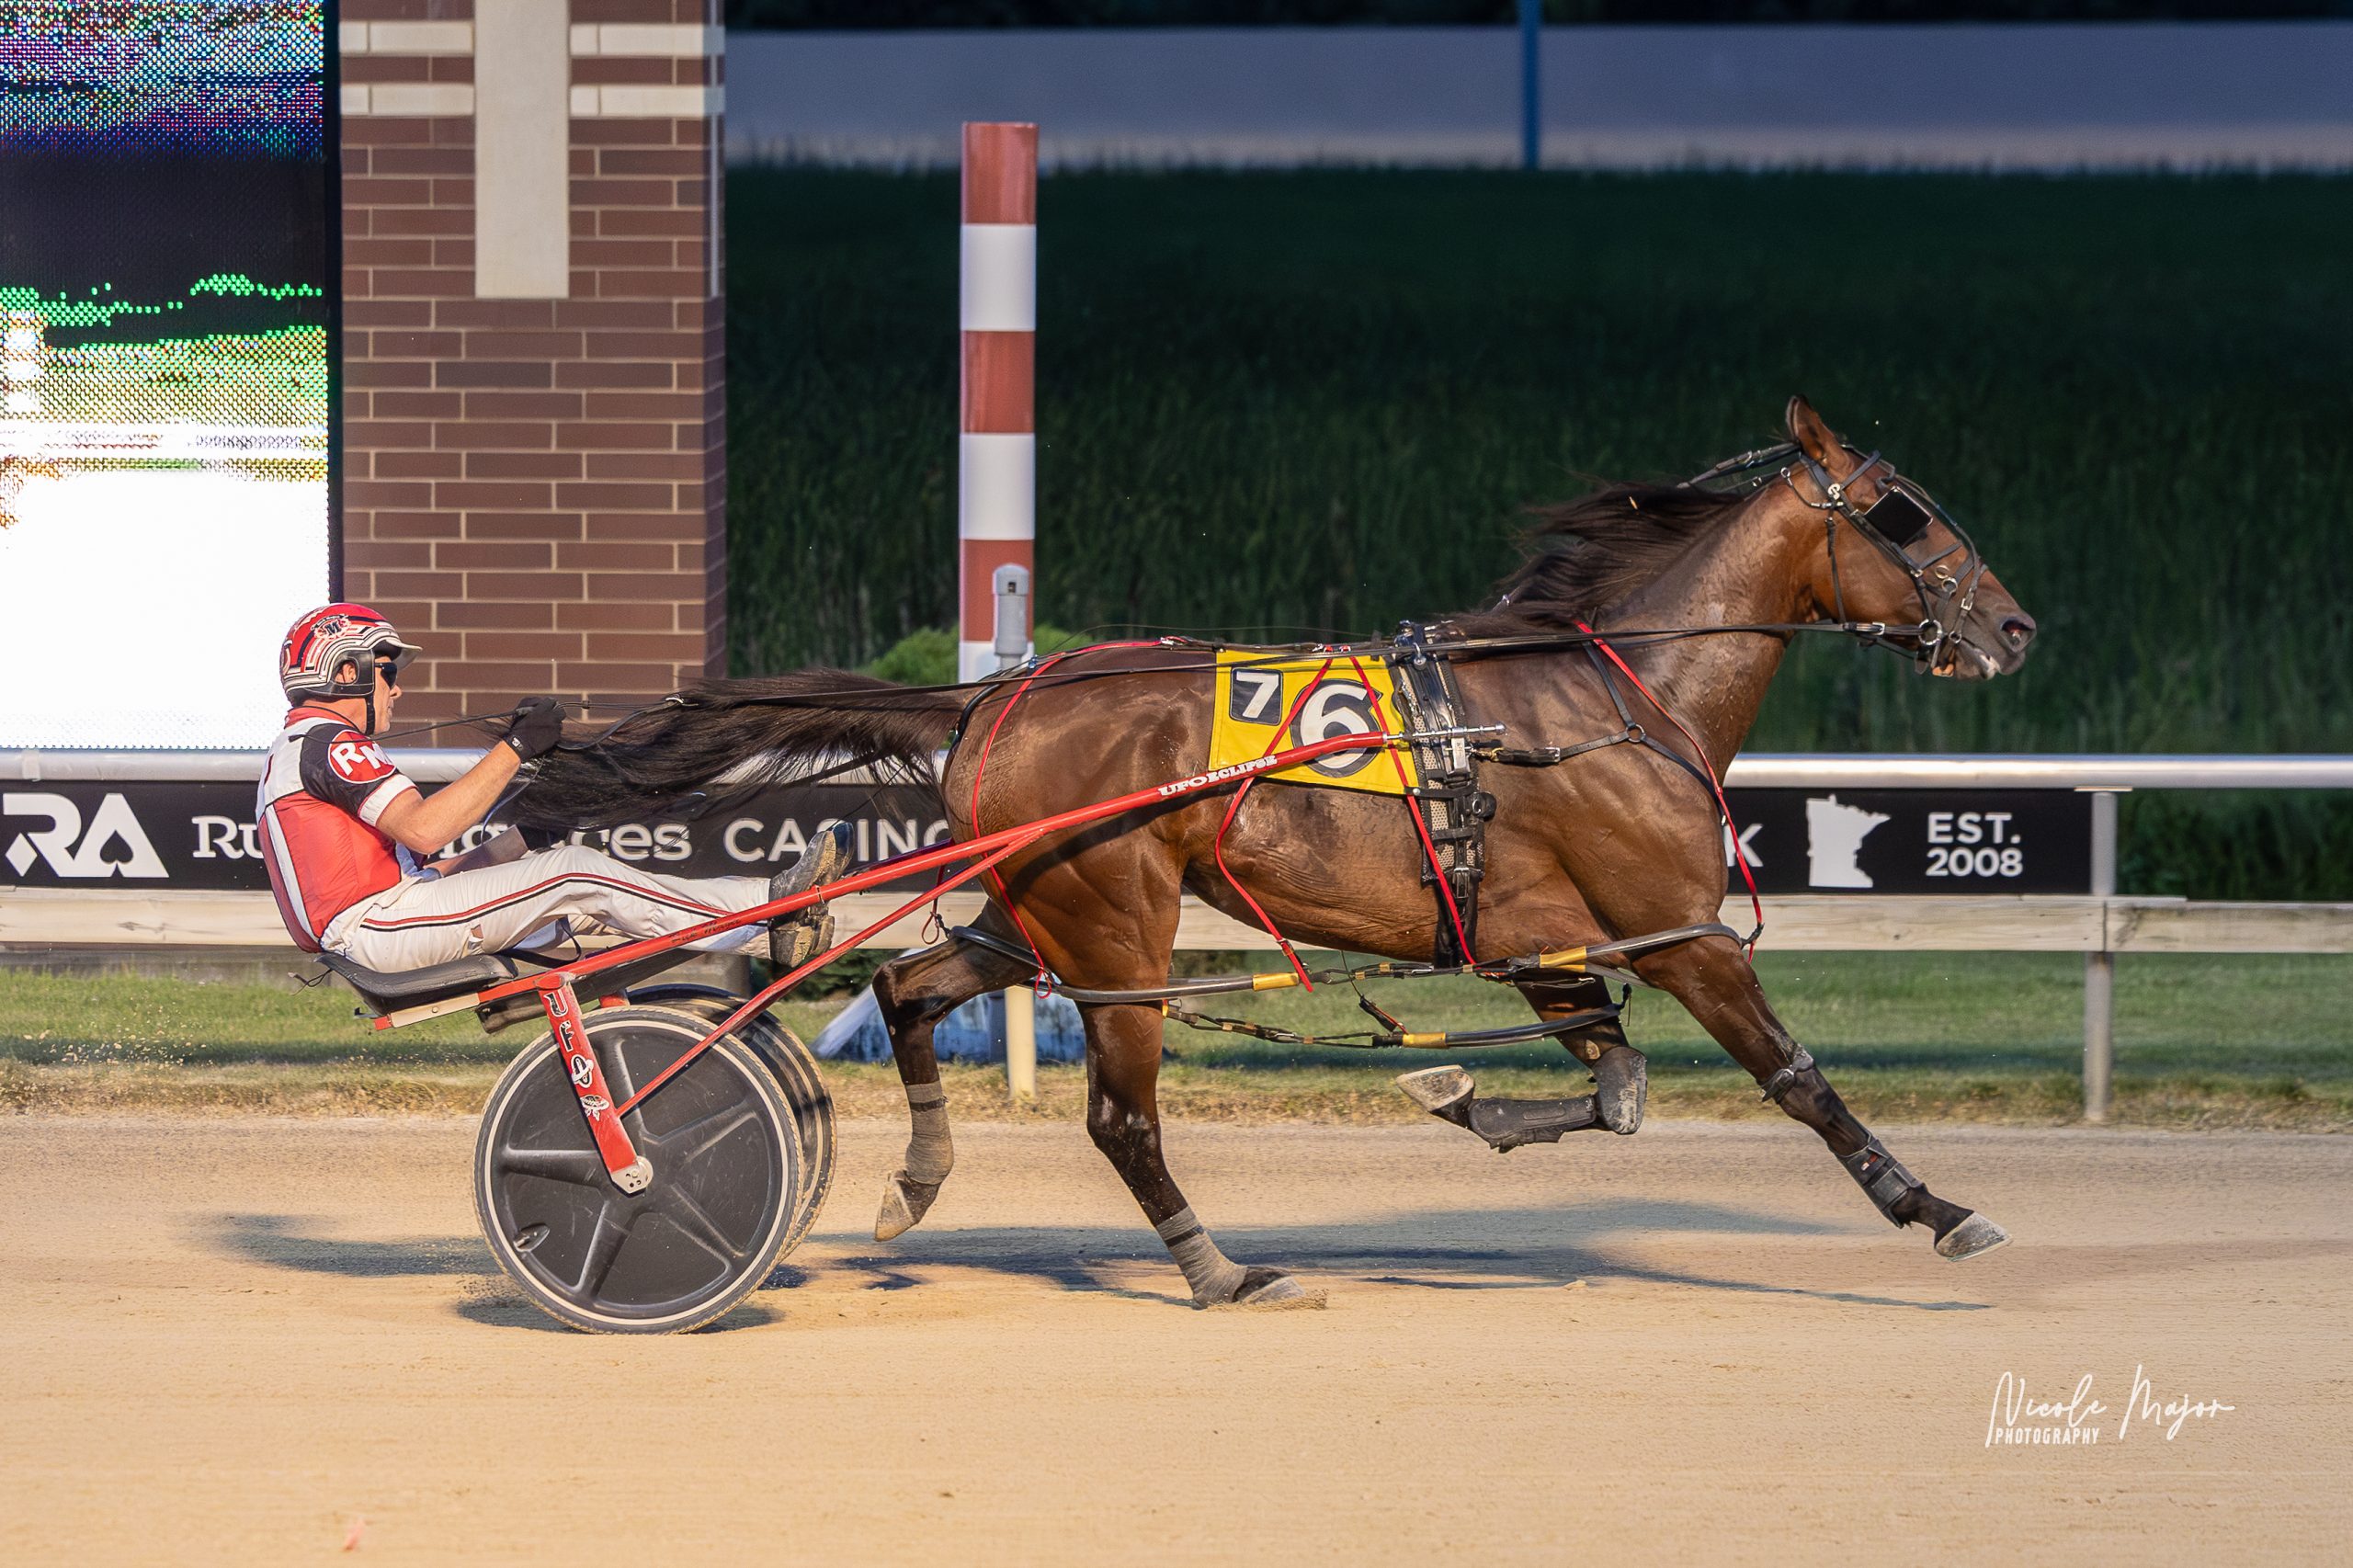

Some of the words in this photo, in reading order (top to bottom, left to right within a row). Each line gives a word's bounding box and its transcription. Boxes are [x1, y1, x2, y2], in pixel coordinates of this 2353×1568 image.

[1235, 672, 1281, 719] 7
[1299, 684, 1371, 768] 6
[723, 817, 950, 862] CAIN
[1927, 812, 2021, 844] EST.
[1926, 847, 2023, 877] 2008
